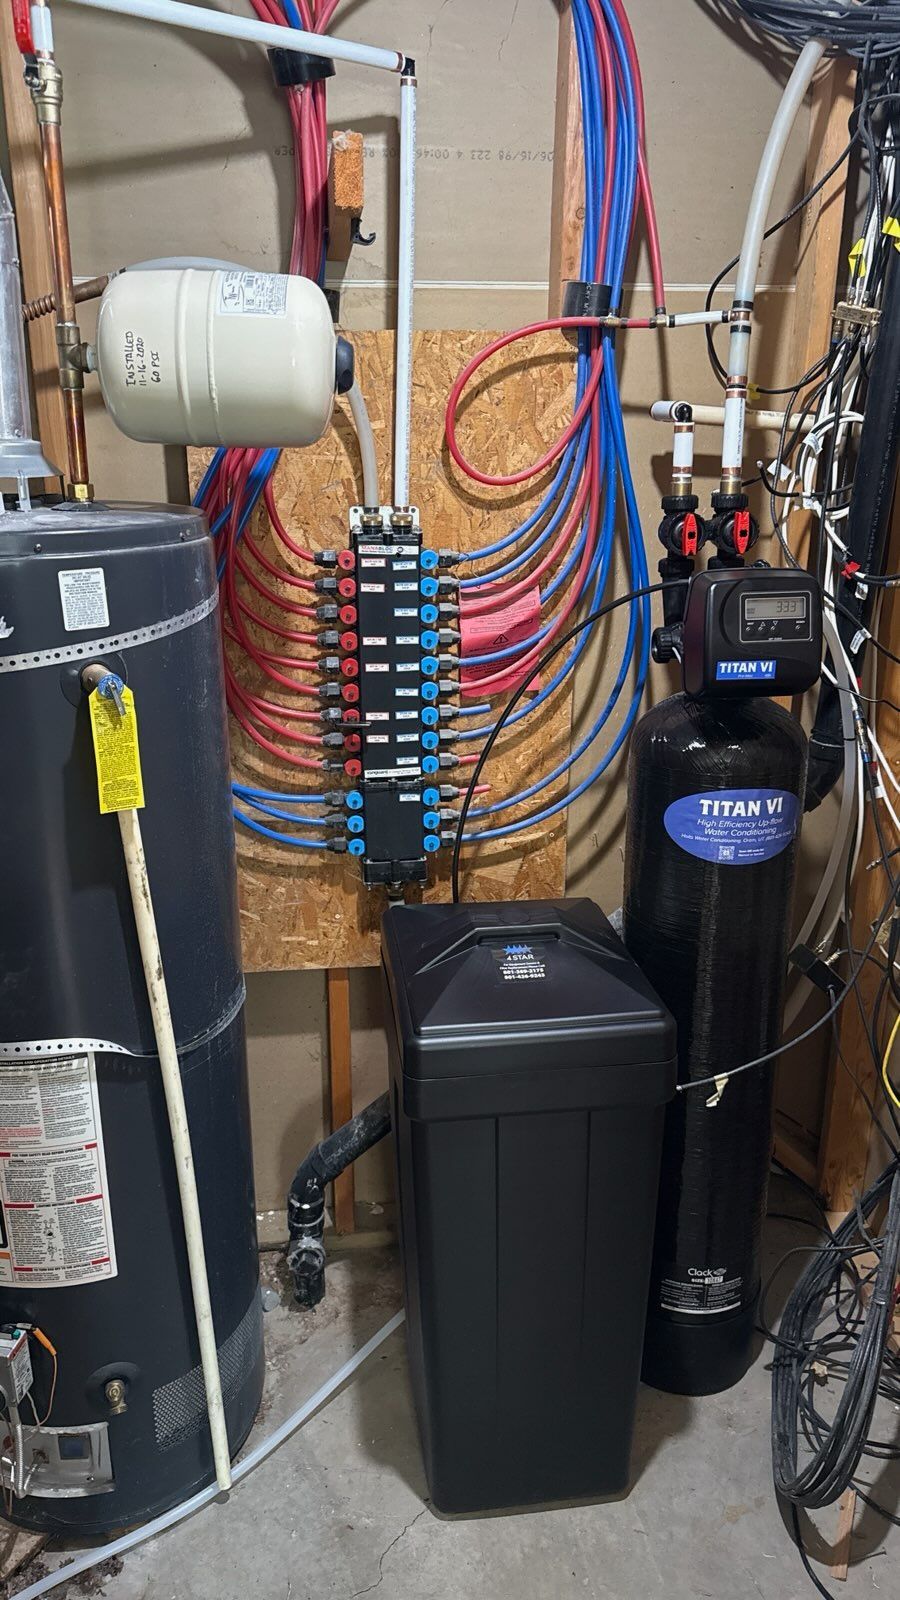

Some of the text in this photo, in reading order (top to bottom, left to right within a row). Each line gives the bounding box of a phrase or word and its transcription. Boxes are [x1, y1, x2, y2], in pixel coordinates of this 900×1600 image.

[415, 149, 449, 160] 00:46
[456, 151, 463, 160] 4
[498, 150, 555, 162] 06/16/98
[124, 331, 136, 387] INSTALLED
[136, 337, 146, 386] 11-16-2020
[150, 350, 161, 383] 60 PSI
[776, 600, 797, 613] 333
[719, 662, 773, 674] TITAN VI
[699, 797, 783, 817] TITAN VI
[697, 817, 784, 829] High Efficiency Up-flow
[704, 828, 728, 836] Water
[730, 827, 777, 837] Conditioning
[687, 1267, 713, 1278] Clack
